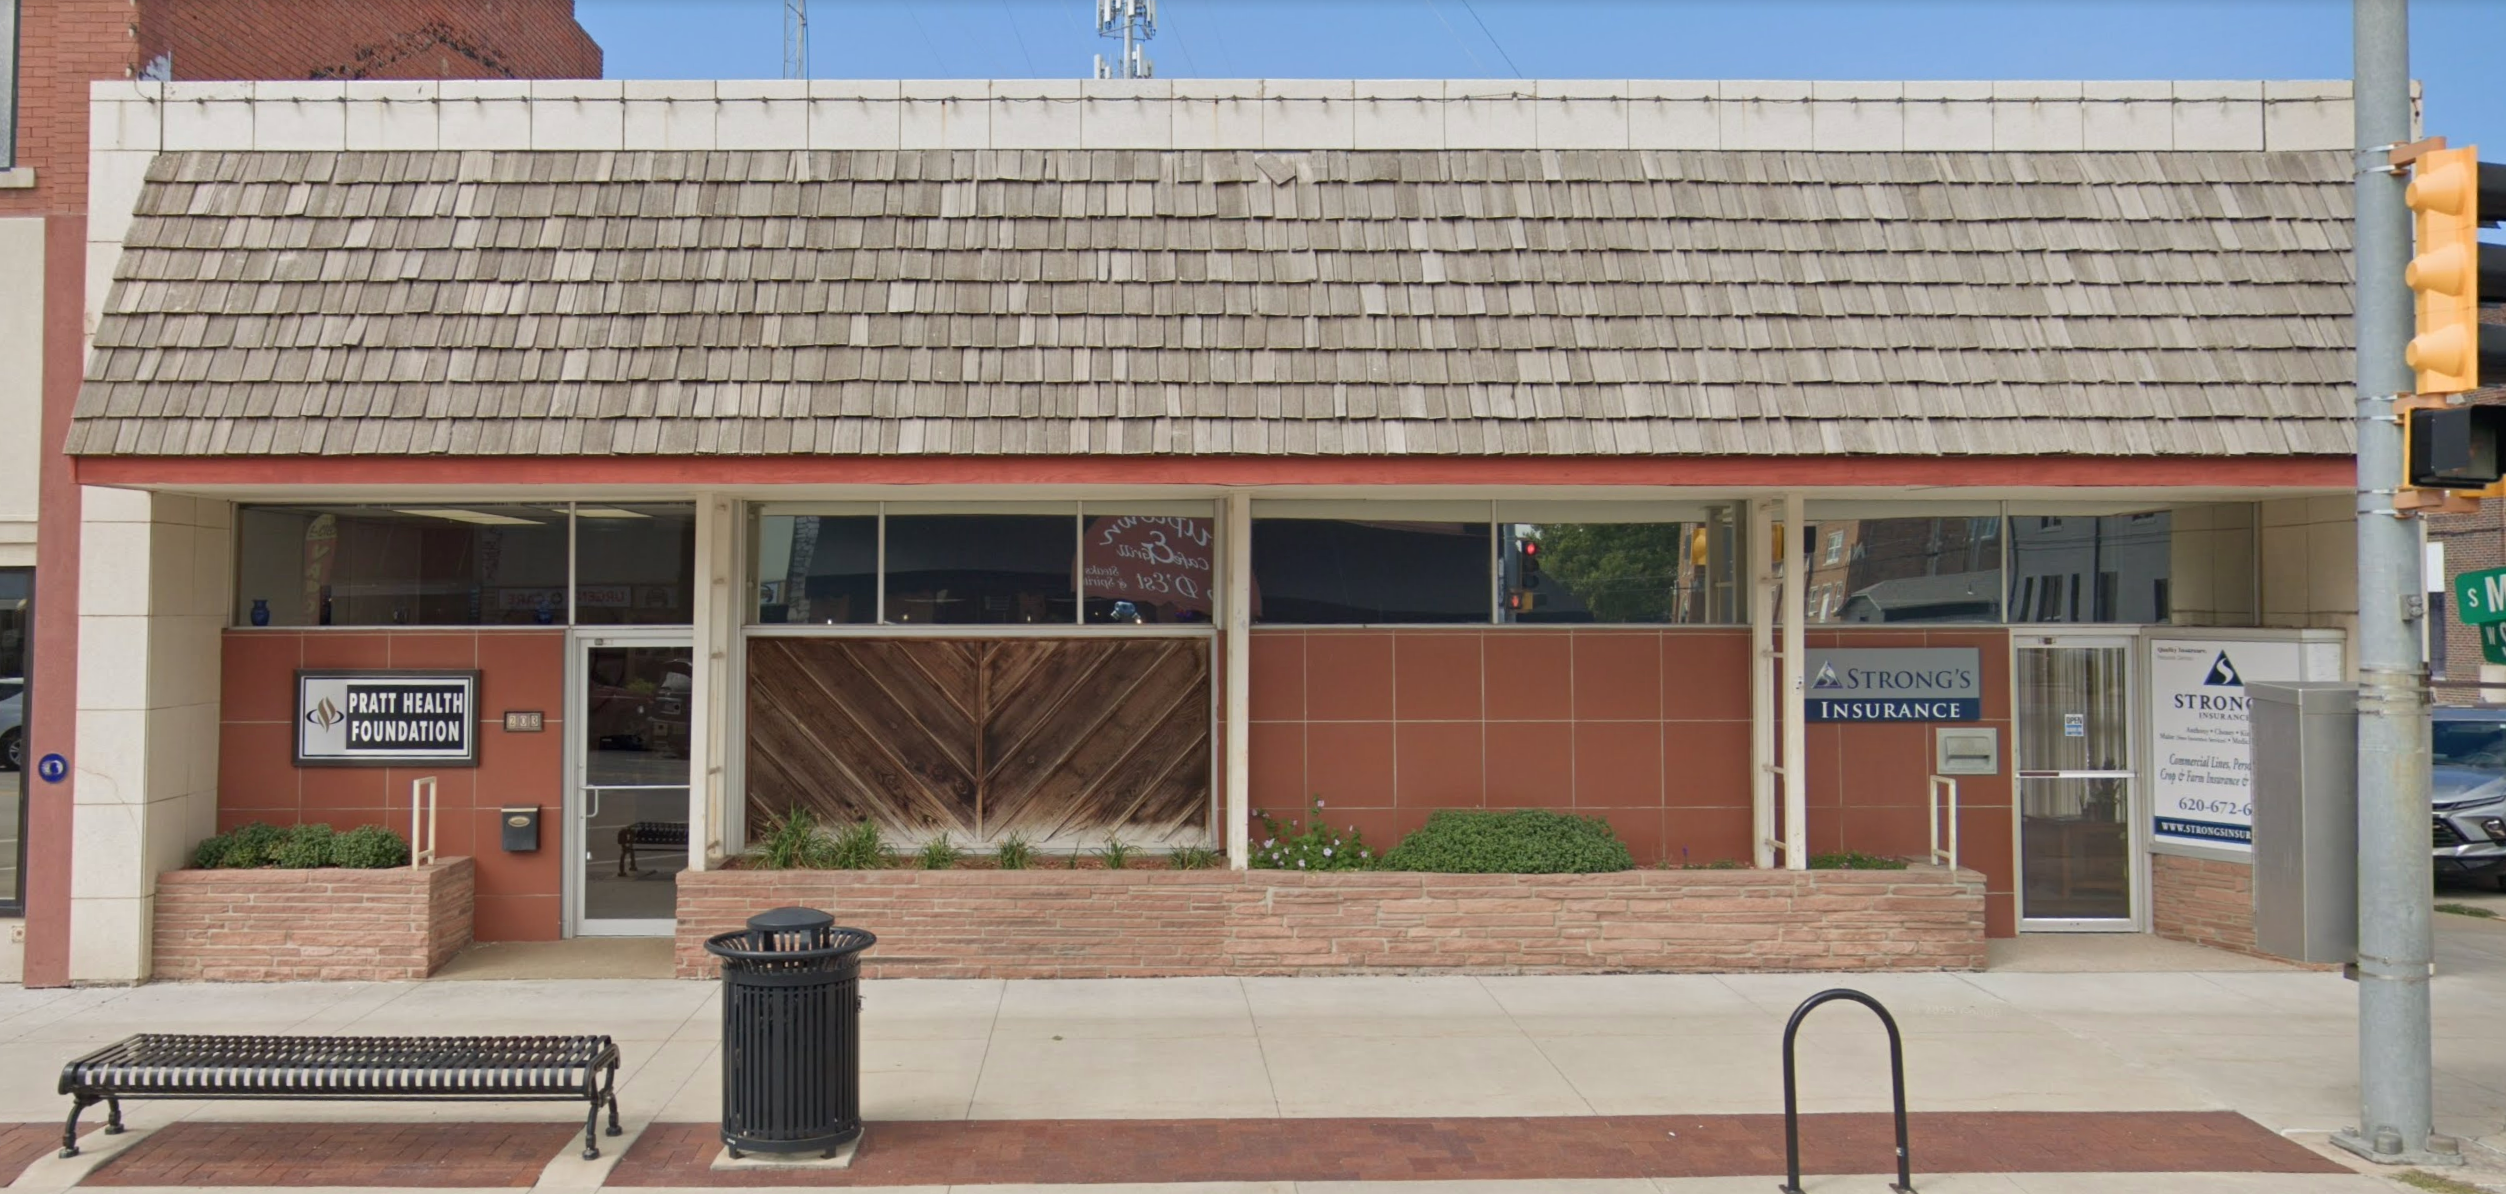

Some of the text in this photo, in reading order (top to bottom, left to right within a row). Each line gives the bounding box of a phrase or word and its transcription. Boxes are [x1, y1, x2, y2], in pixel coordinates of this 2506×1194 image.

[2467, 587, 2479, 608] S
[1847, 668, 1971, 689] STRONG'S
[349, 692, 463, 714] PRATT HEALTH
[1821, 701, 1960, 719] INSURANCE
[351, 720, 460, 742] FOUNDATION
[2169, 753, 2210, 768] Commercial
[2160, 768, 2176, 785] Crop
[2187, 770, 2205, 783] Farm
[2206, 772, 2240, 786] Insurance
